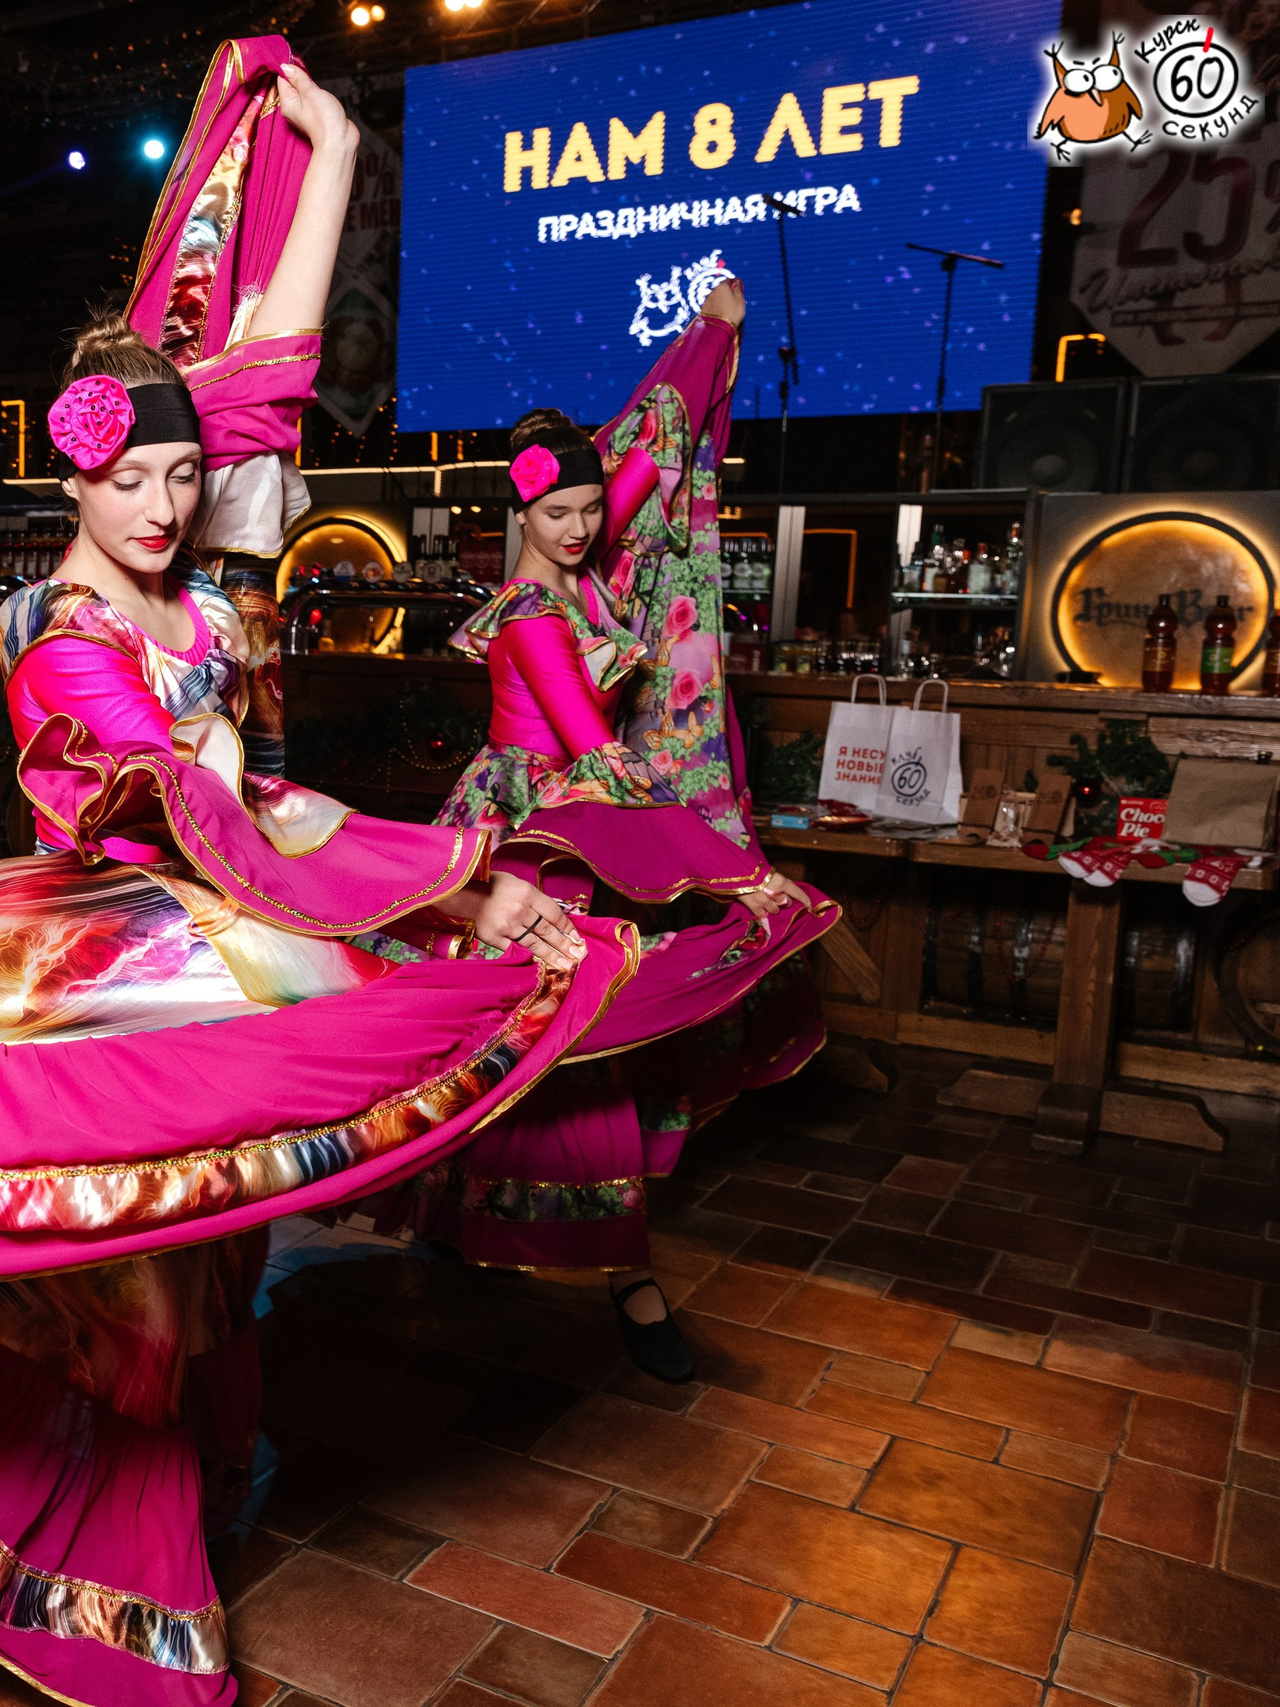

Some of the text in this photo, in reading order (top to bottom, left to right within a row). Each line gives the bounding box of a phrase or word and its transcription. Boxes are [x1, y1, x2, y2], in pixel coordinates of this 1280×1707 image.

[503, 75, 920, 193] НАМ 8 ЛЕТ
[537, 193, 766, 243] ПРАЗДНИЧНАЯ
[838, 746, 848, 757] Я
[898, 767, 921, 789] 60
[1120, 807, 1166, 824] Choc
[1119, 822, 1150, 838] Pie
